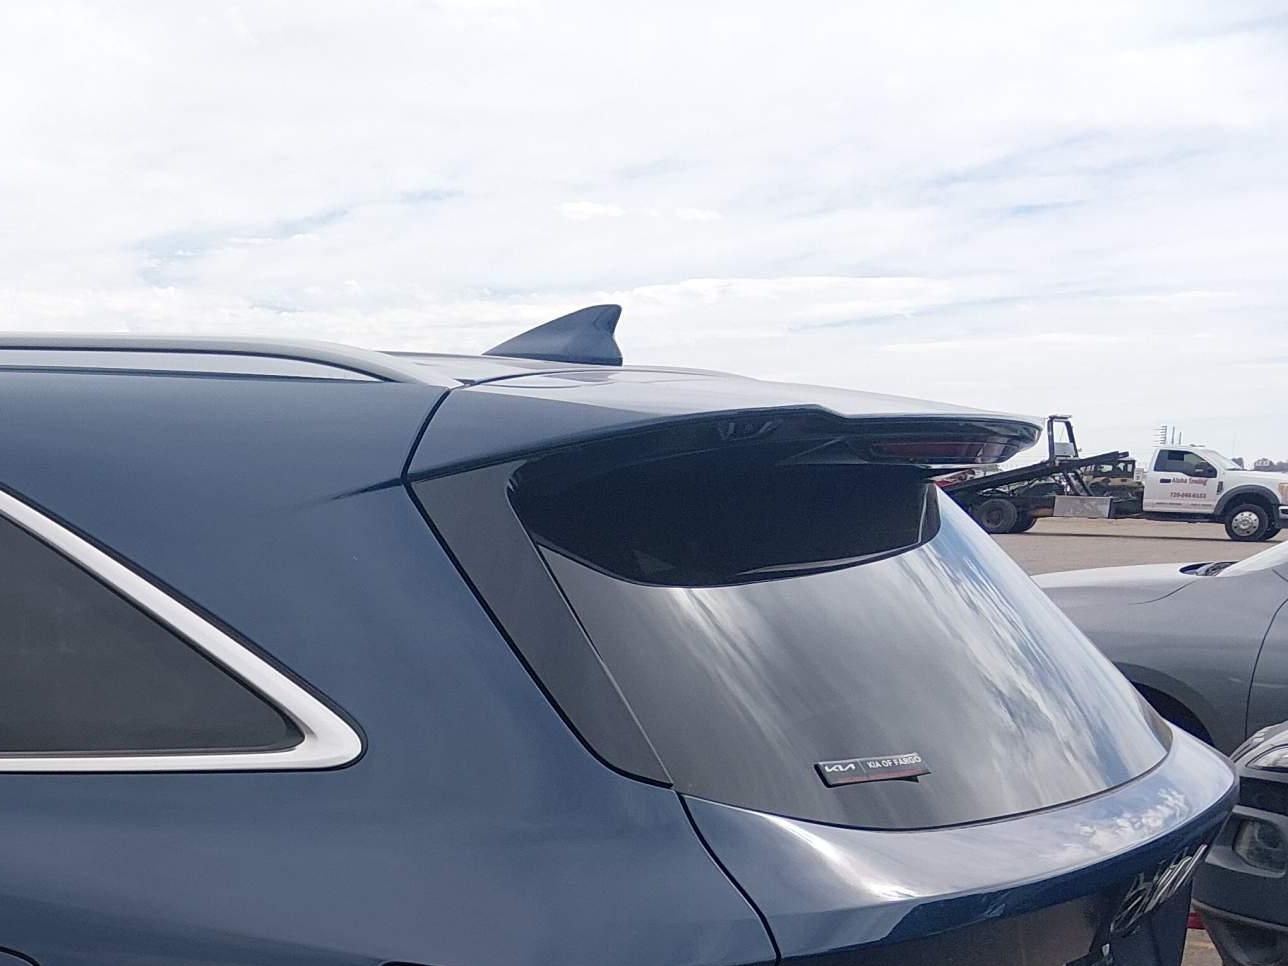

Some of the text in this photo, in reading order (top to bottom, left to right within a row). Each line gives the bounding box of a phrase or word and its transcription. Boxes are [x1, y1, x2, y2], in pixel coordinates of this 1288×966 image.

[824, 763, 855, 773] KIA
[867, 755, 922, 769] KIA OF FARGO
